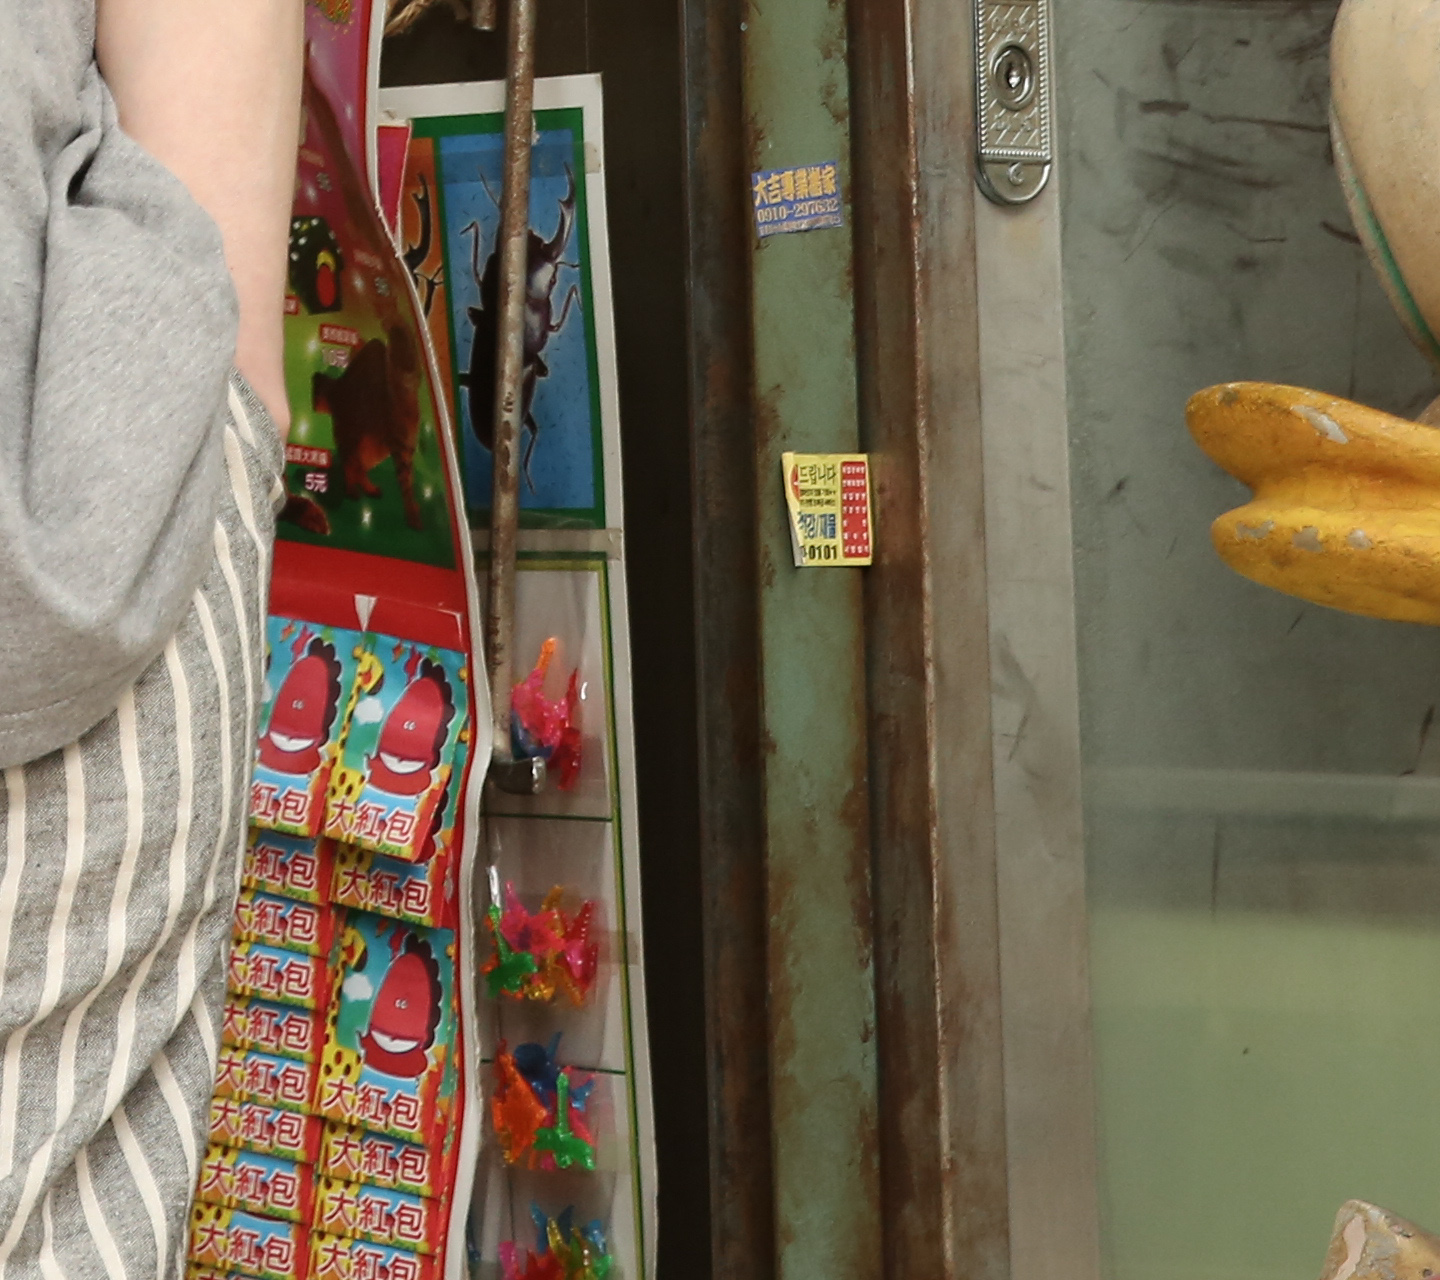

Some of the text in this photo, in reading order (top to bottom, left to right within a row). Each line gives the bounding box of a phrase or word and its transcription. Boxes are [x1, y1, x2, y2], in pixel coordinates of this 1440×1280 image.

[305, 472, 328, 493] 5元
[325, 796, 418, 846] 大紅包
[338, 866, 431, 916] 大紅包
[228, 948, 314, 998] 大紅包
[222, 1002, 312, 1052] 大紅包
[215, 1054, 309, 1104] 大紅包
[321, 1076, 421, 1132] 大紅包
[209, 1099, 307, 1150] 大紅包
[201, 1157, 300, 1210] 大紅包
[327, 1134, 429, 1186] 大紅包
[322, 1188, 427, 1242] 大紅包
[195, 1220, 294, 1275] 大紅包
